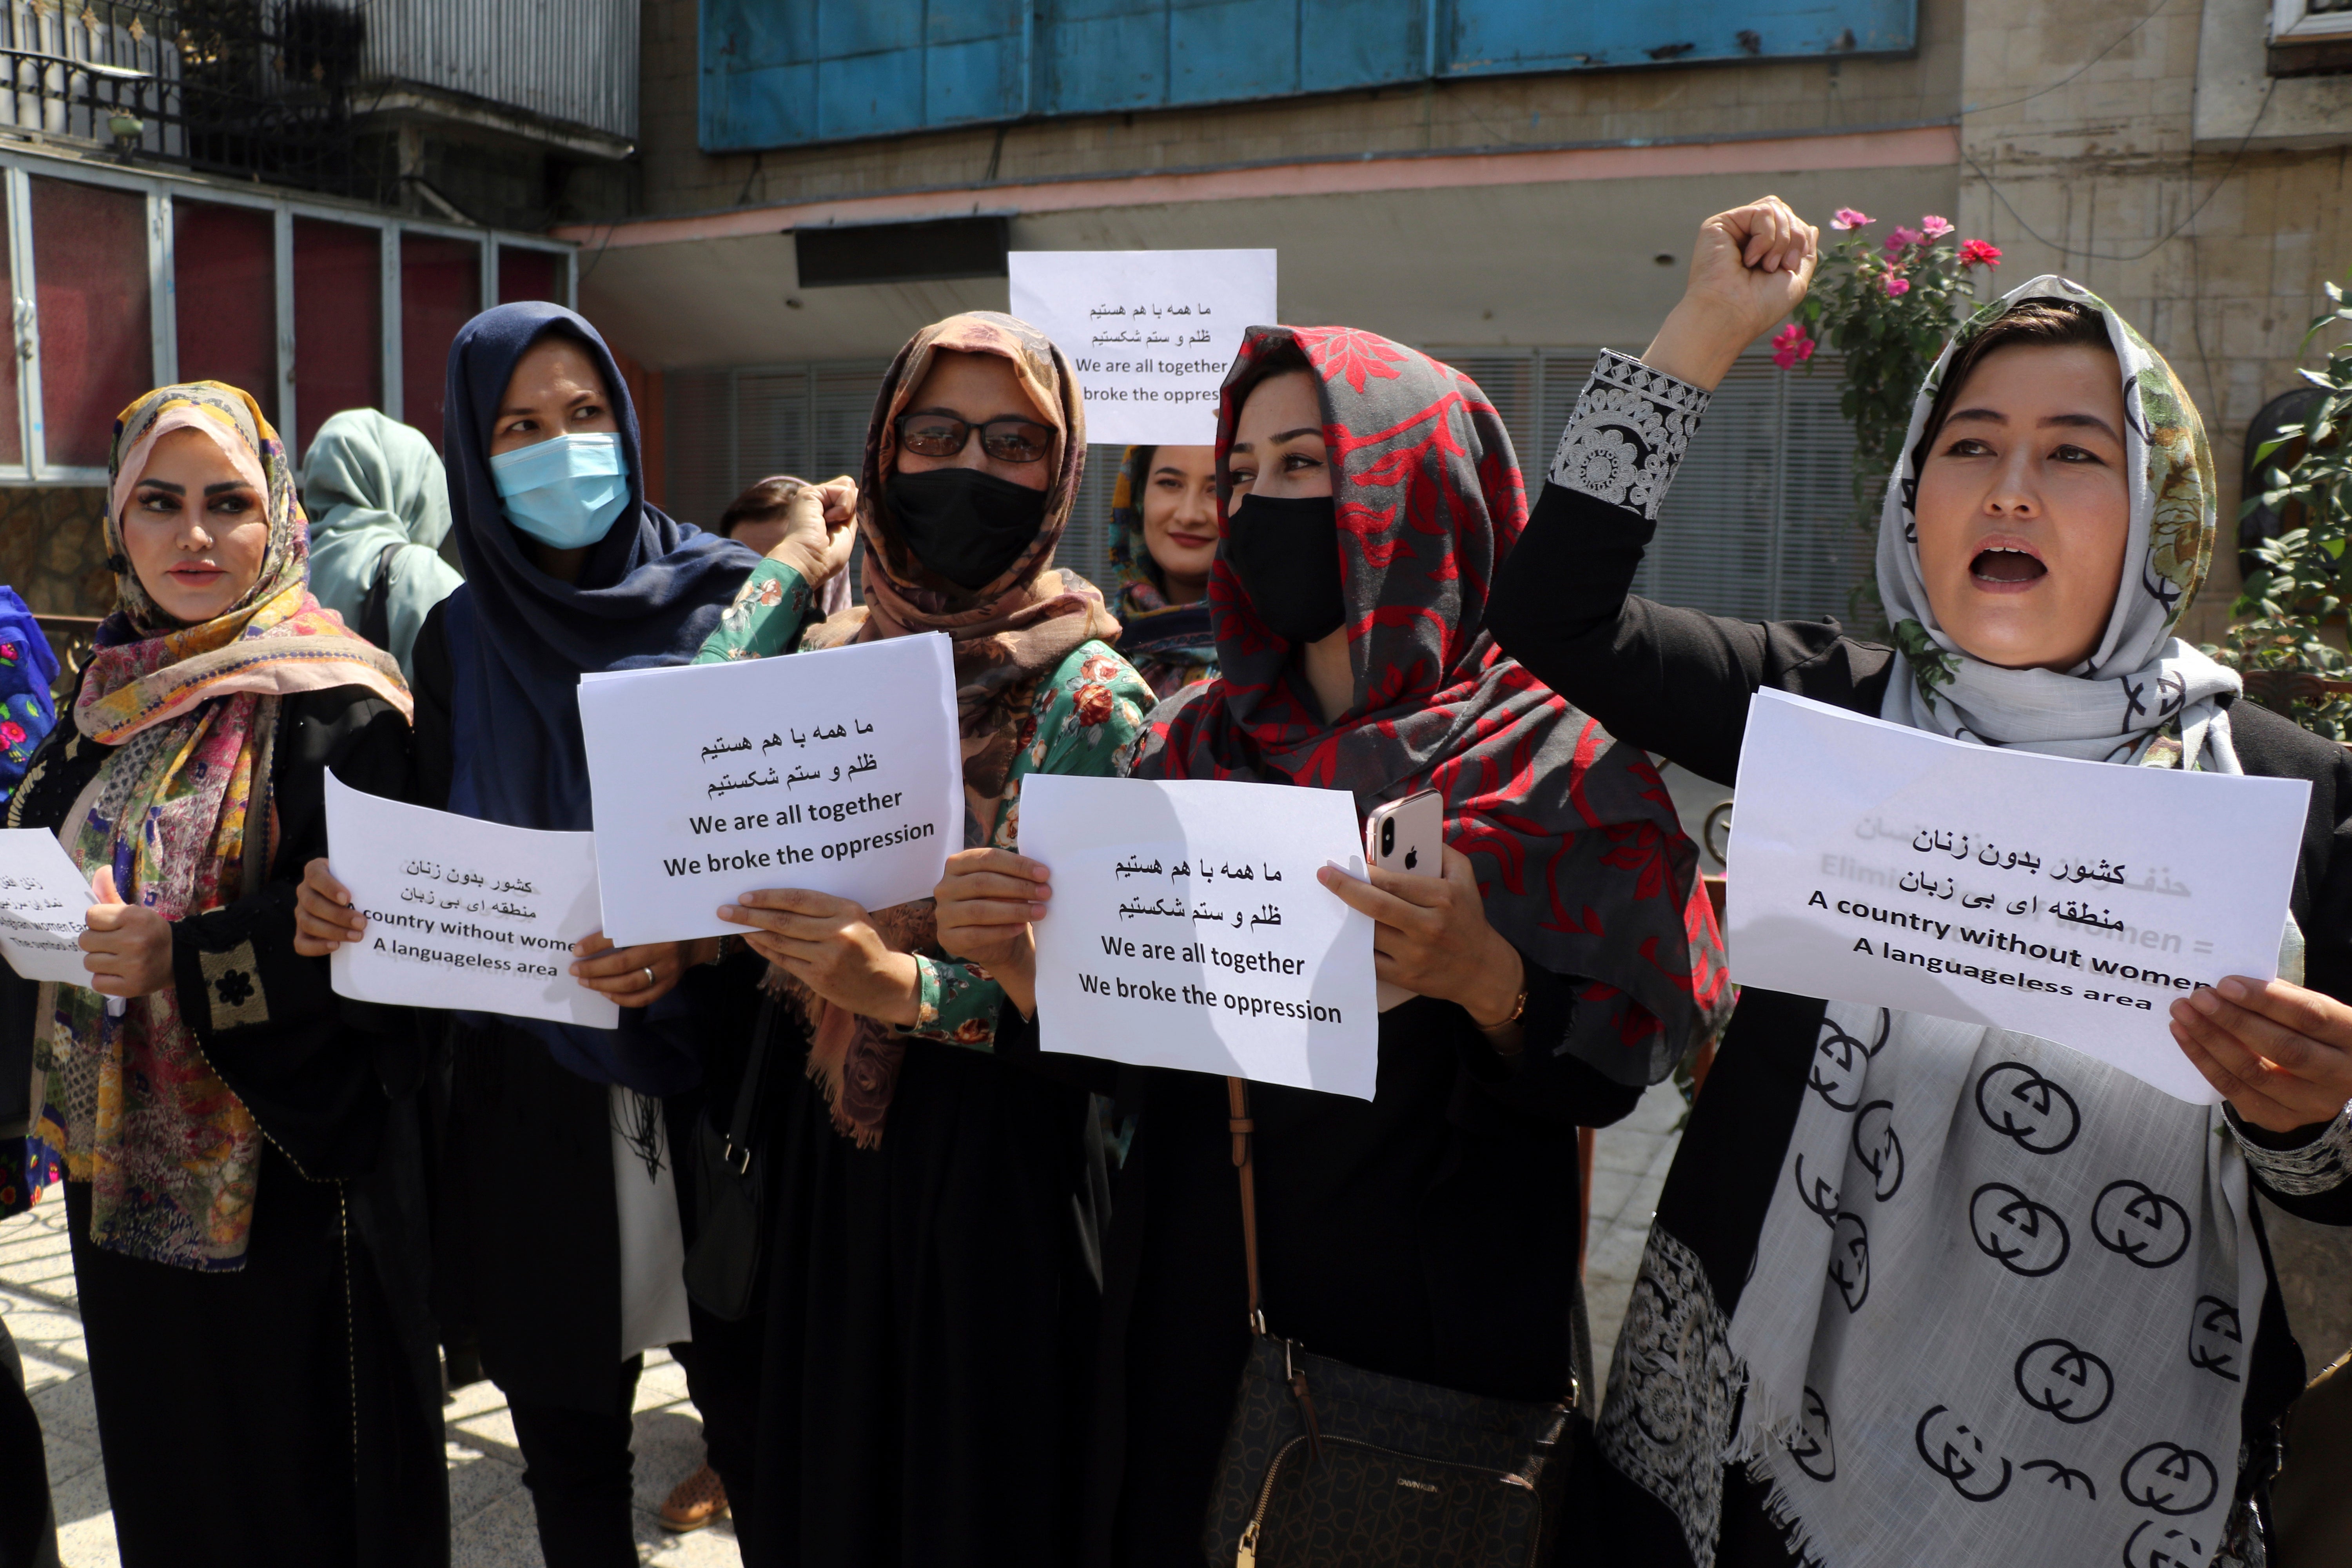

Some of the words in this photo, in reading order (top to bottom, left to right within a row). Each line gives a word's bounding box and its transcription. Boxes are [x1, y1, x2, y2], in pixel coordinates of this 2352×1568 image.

[1090, 304, 1126, 320] هستیم
[1132, 305, 1147, 321] هم
[1152, 303, 1162, 319] با
[1167, 305, 1191, 316] همه
[1198, 303, 1211, 315] ما
[1092, 330, 1142, 348] شکستیم
[1146, 331, 1170, 348] ستم
[1175, 335, 1184, 347] و
[1189, 329, 1211, 348] ظلم
[1075, 358, 1101, 372] We
[1105, 362, 1131, 372] are
[1135, 358, 1153, 373] all
[1158, 359, 1228, 376] together
[1083, 386, 1128, 401] broke
[1132, 387, 1159, 401] the
[1163, 390, 1219, 404] oppres
[813, 724, 847, 740] همه
[855, 719, 873, 734] ما
[762, 733, 782, 756] هم
[790, 728, 806, 748] با
[701, 737, 752, 763] هستیم
[829, 766, 840, 782] و
[848, 753, 877, 782] ظلم
[708, 768, 779, 800] شکستیم
[787, 765, 820, 791] ستم
[689, 815, 727, 835] We
[734, 814, 769, 830] are
[776, 804, 802, 826] all
[808, 792, 902, 822] together
[663, 857, 701, 877] We
[707, 850, 770, 872] broke
[776, 845, 814, 865] the
[821, 823, 934, 861] oppression
[1913, 830, 1968, 860] زنان
[1978, 844, 2040, 869] بدون
[407, 861, 440, 879] زنان
[1115, 855, 1162, 880] هستیم
[1171, 860, 1191, 885] هم
[1200, 858, 1213, 883] با
[1221, 862, 1254, 880] همه
[1263, 862, 1282, 881] ما
[2050, 859, 2125, 884] کشور
[447, 869, 483, 887] بدون
[492, 879, 532, 893] کشور
[1899, 871, 1953, 900] زبان
[401, 888, 434, 904] زبان
[440, 900, 459, 909] بی
[1962, 894, 1994, 909] بی
[2006, 896, 2036, 915] ای
[467, 900, 485, 912] ای
[492, 902, 536, 918] منطقه
[1119, 897, 1185, 921] شکستیم
[1192, 902, 1223, 927] ستم
[1231, 911, 1243, 929] و
[1250, 904, 1281, 933] ظلم
[2048, 901, 2124, 932] منطقه
[30, 922, 71, 932] women
[68, 922, 89, 933] Ear
[363, 909, 435, 933] country
[441, 922, 514, 944] without
[521, 936, 575, 952] wome
[1808, 890, 1828, 909] A
[1837, 900, 1951, 940] country
[1960, 927, 2082, 967] without
[9, 937, 34, 948] The
[31, 941, 70, 951] symbol
[374, 938, 386, 951] A
[392, 940, 511, 970] languageless
[517, 963, 557, 976] area
[1101, 936, 1135, 957] We
[1142, 944, 1175, 961] are
[1182, 942, 1205, 964] all
[1211, 947, 1305, 975] together
[1853, 938, 1873, 955] A
[1884, 942, 2073, 995] languageless
[2083, 990, 2152, 1010] area
[1078, 973, 1111, 996] We
[1116, 977, 1176, 1002] broke
[1182, 984, 1217, 1007] the
[1224, 994, 1341, 1024] oppression
[1397, 1478, 1420, 1489] CALVIN
[1421, 1483, 1439, 1493] KLEIN
